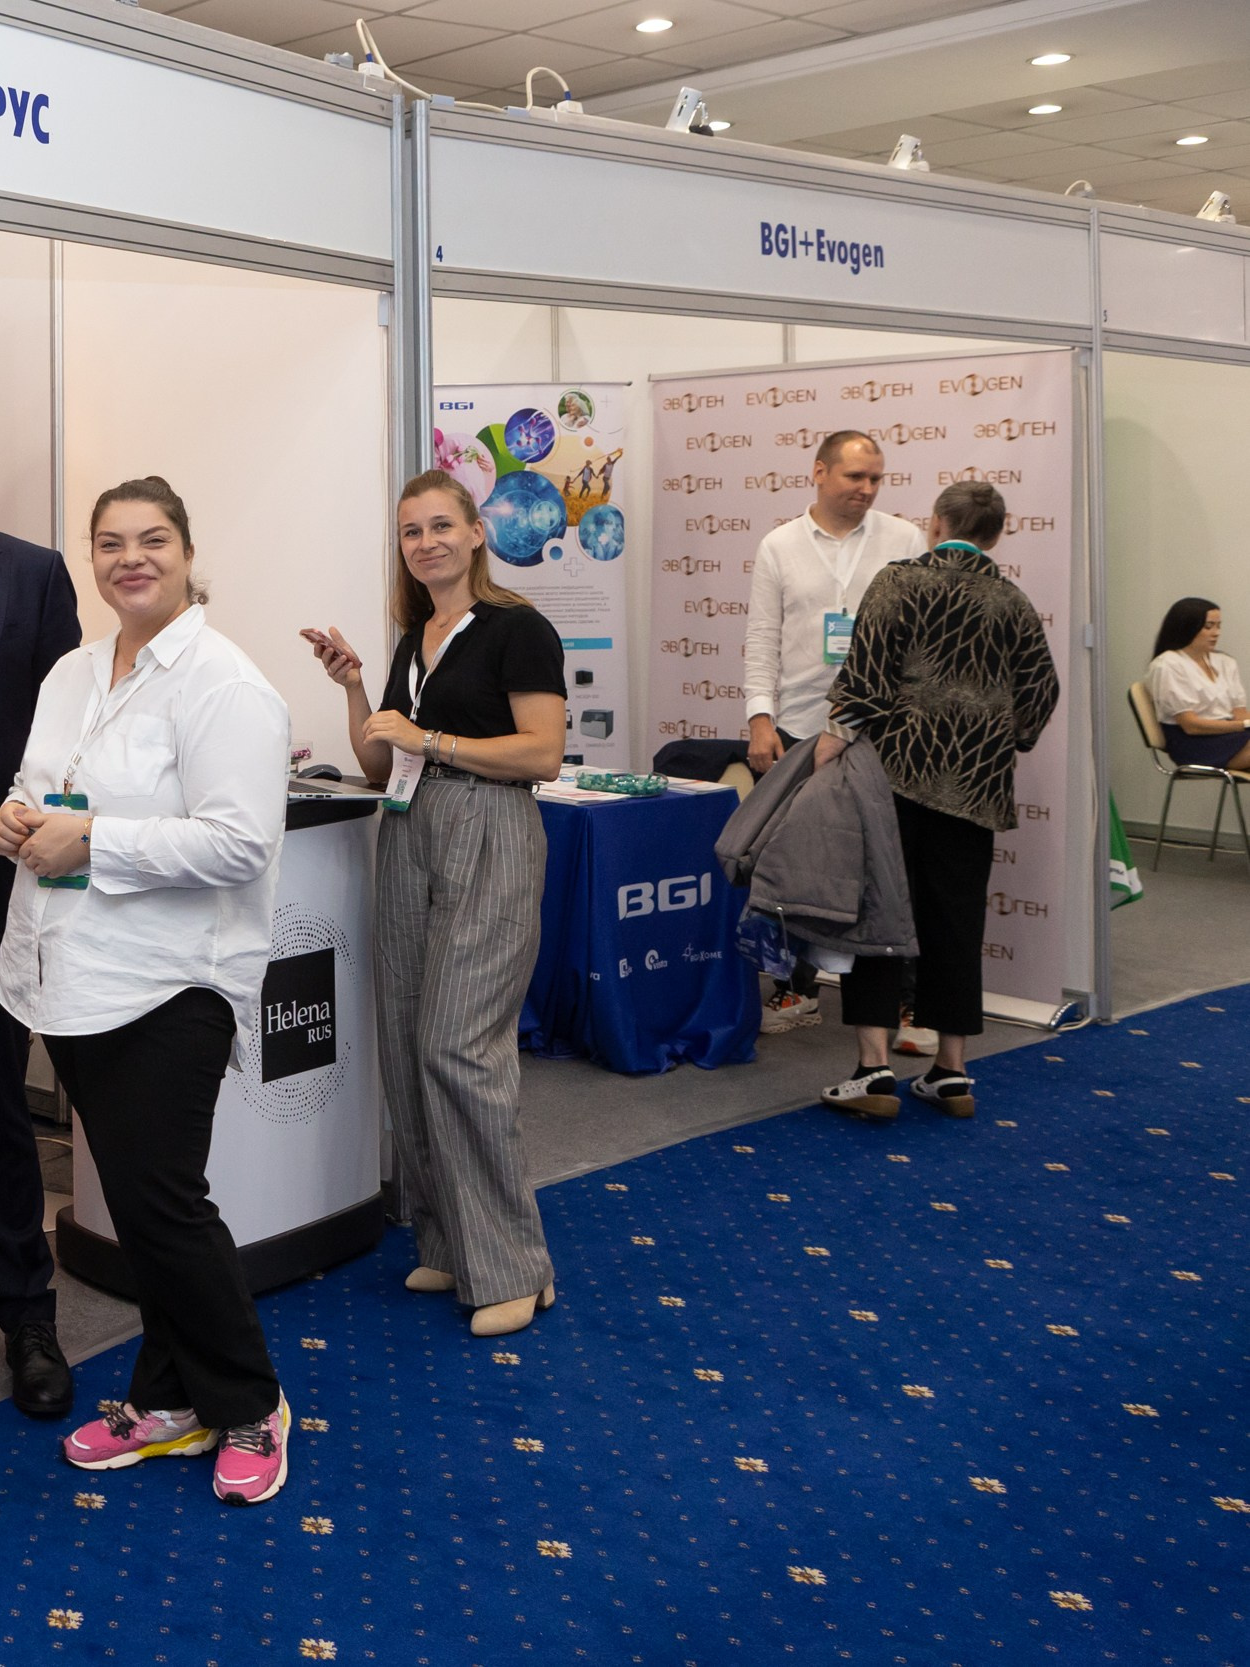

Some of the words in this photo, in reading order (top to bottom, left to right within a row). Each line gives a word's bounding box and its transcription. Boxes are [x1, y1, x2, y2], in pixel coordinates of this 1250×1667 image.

[436, 245, 443, 263] 4
[760, 221, 884, 275] BGI+Evogen
[440, 401, 474, 410] BGI
[617, 872, 712, 921] BGI
[266, 1000, 331, 1034] Helena
[308, 1024, 332, 1043] RUS
